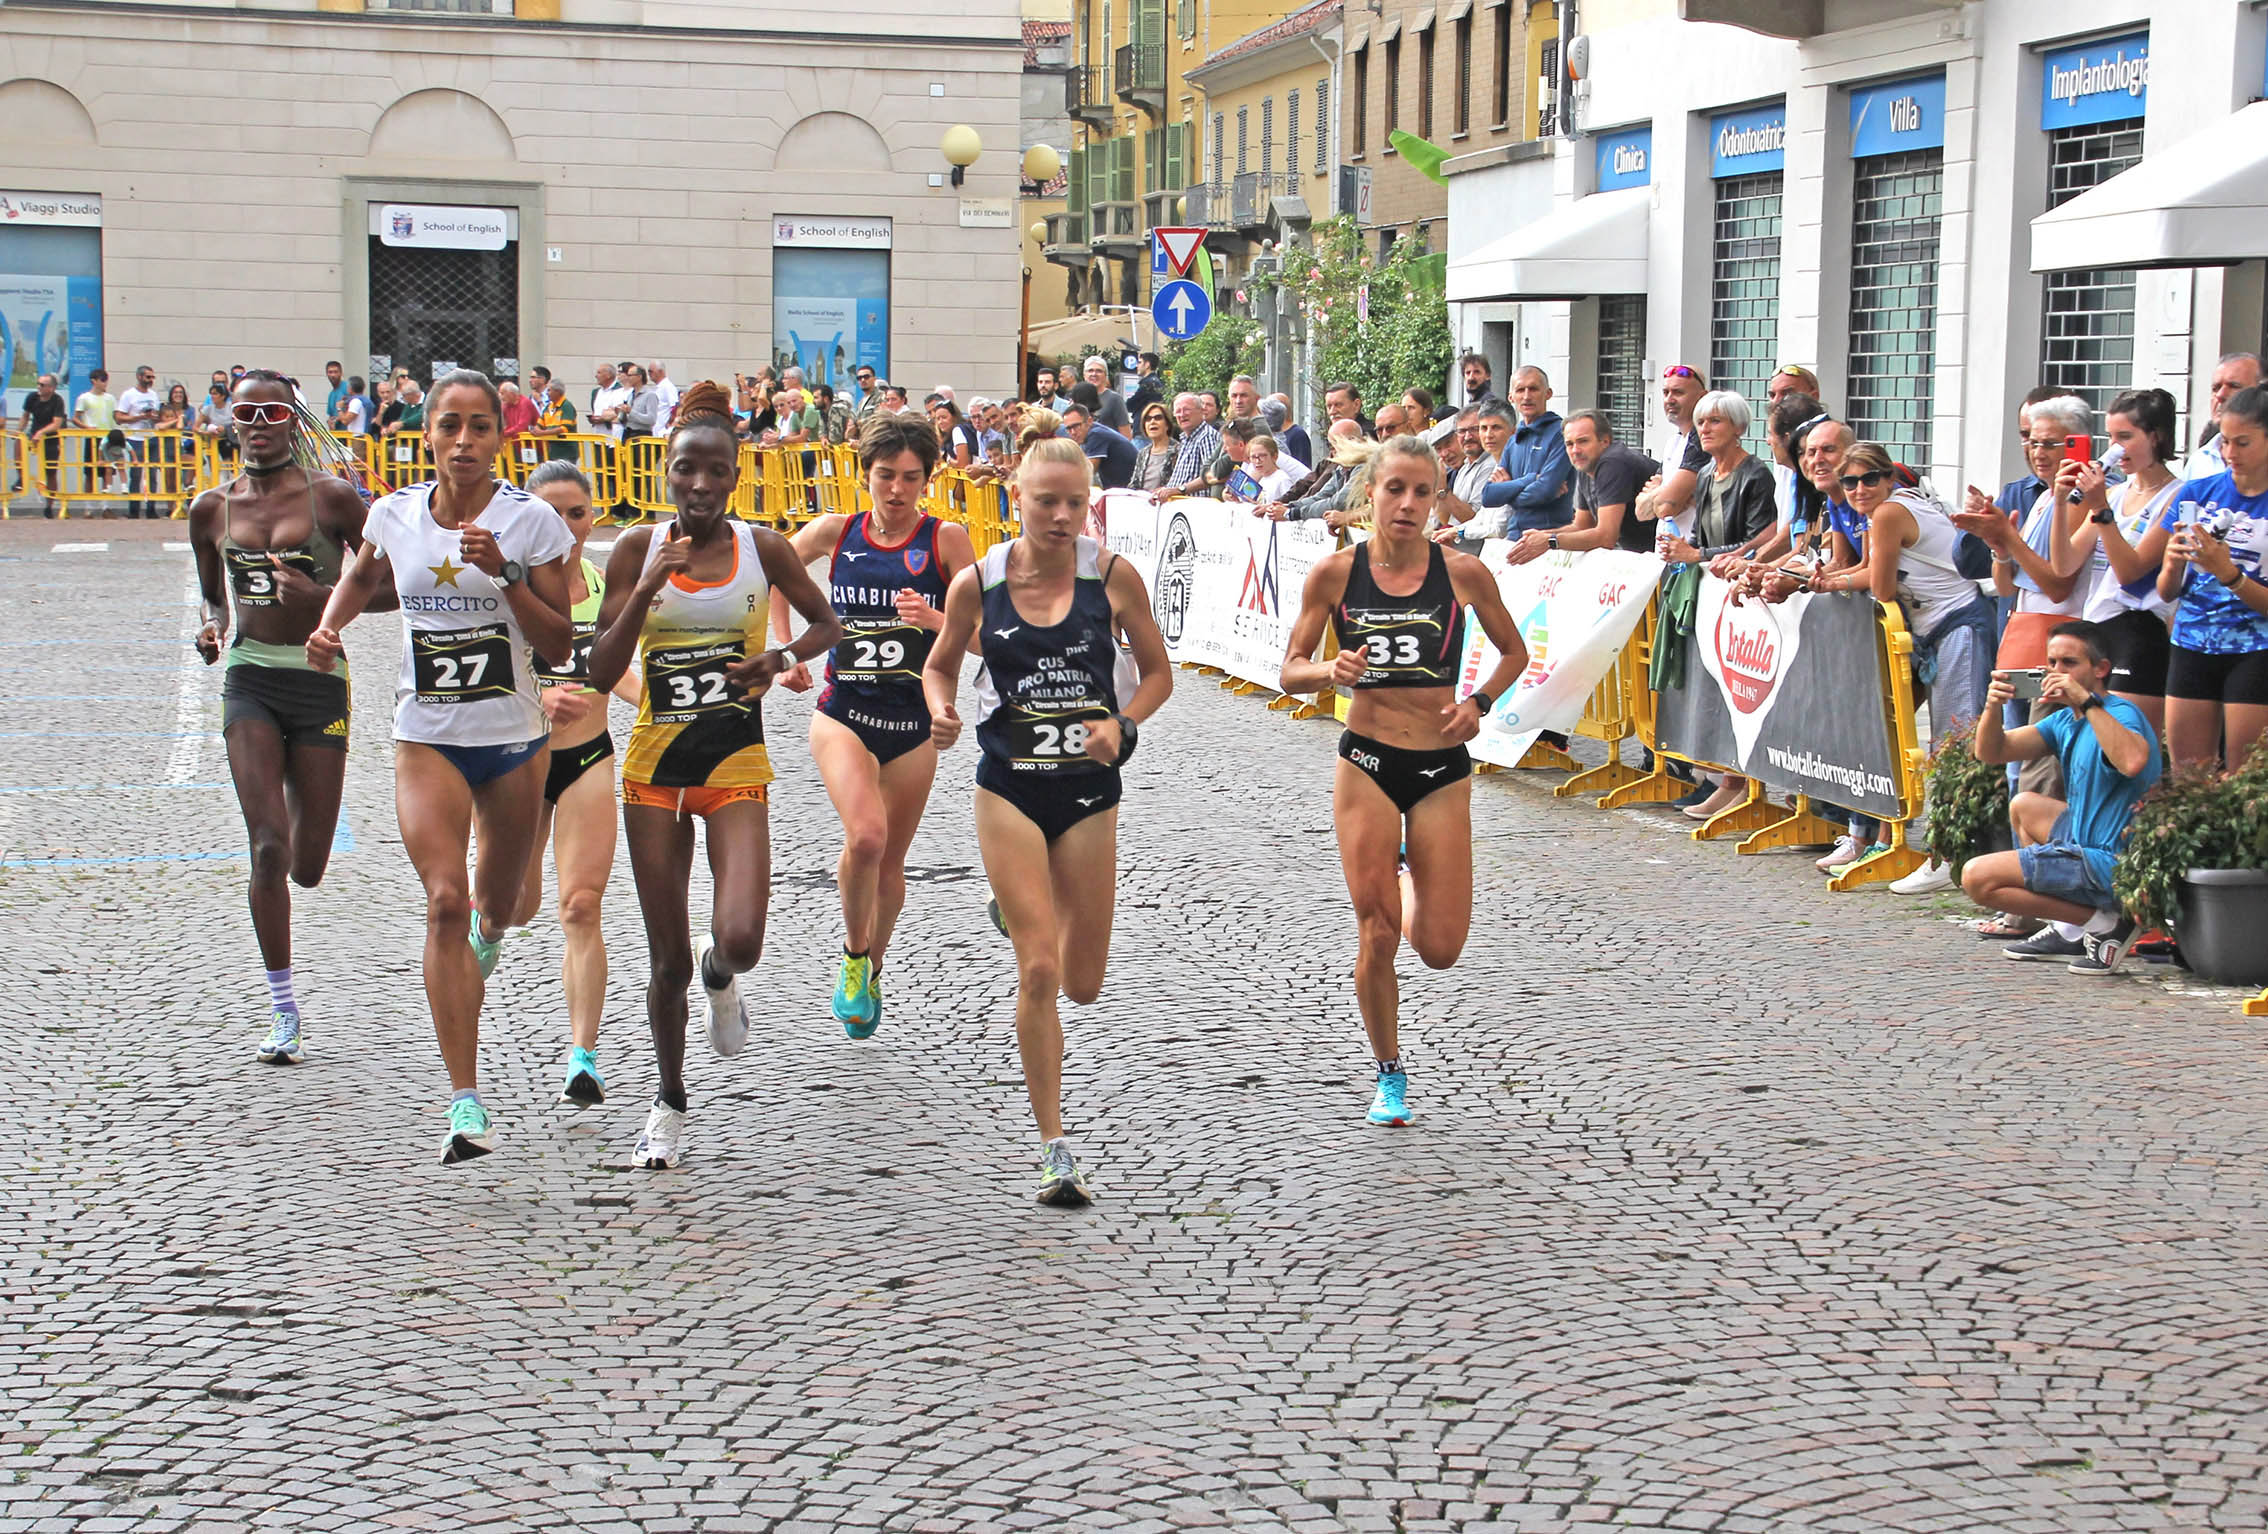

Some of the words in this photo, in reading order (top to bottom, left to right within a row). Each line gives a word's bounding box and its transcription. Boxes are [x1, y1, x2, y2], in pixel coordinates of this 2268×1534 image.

[1890, 96, 1920, 132] Villa
[1614, 145, 1645, 174] Clinica
[20, 201, 58, 215] Viaggi
[61, 204, 101, 215] Studio
[423, 222, 455, 231] School
[457, 223, 466, 231] of
[468, 224, 502, 235] English
[799, 226, 836, 236] School
[838, 227, 849, 237] of
[851, 227, 890, 239] English
[401, 595, 498, 612] ESERCITO
[1599, 584, 1626, 607] GAC
[854, 640, 904, 668] 29
[1366, 635, 1420, 664] 33
[1726, 622, 1774, 674] botalla
[432, 653, 489, 687] 27
[1037, 657, 1066, 670] CUS
[668, 672, 728, 707] 32
[1018, 672, 1045, 693] PRO
[1047, 669, 1094, 685] PATRIA
[1030, 684, 1086, 698] MILANO
[418, 695, 439, 703] 3000
[442, 695, 460, 703] TOP
[654, 715, 676, 723] 3000
[677, 713, 698, 722] TOP
[848, 709, 919, 731] CARABINIERI
[1033, 723, 1090, 755] 28
[1012, 762, 1035, 770] 3000
[1767, 745, 1895, 798] www.botallaformaggi.com
